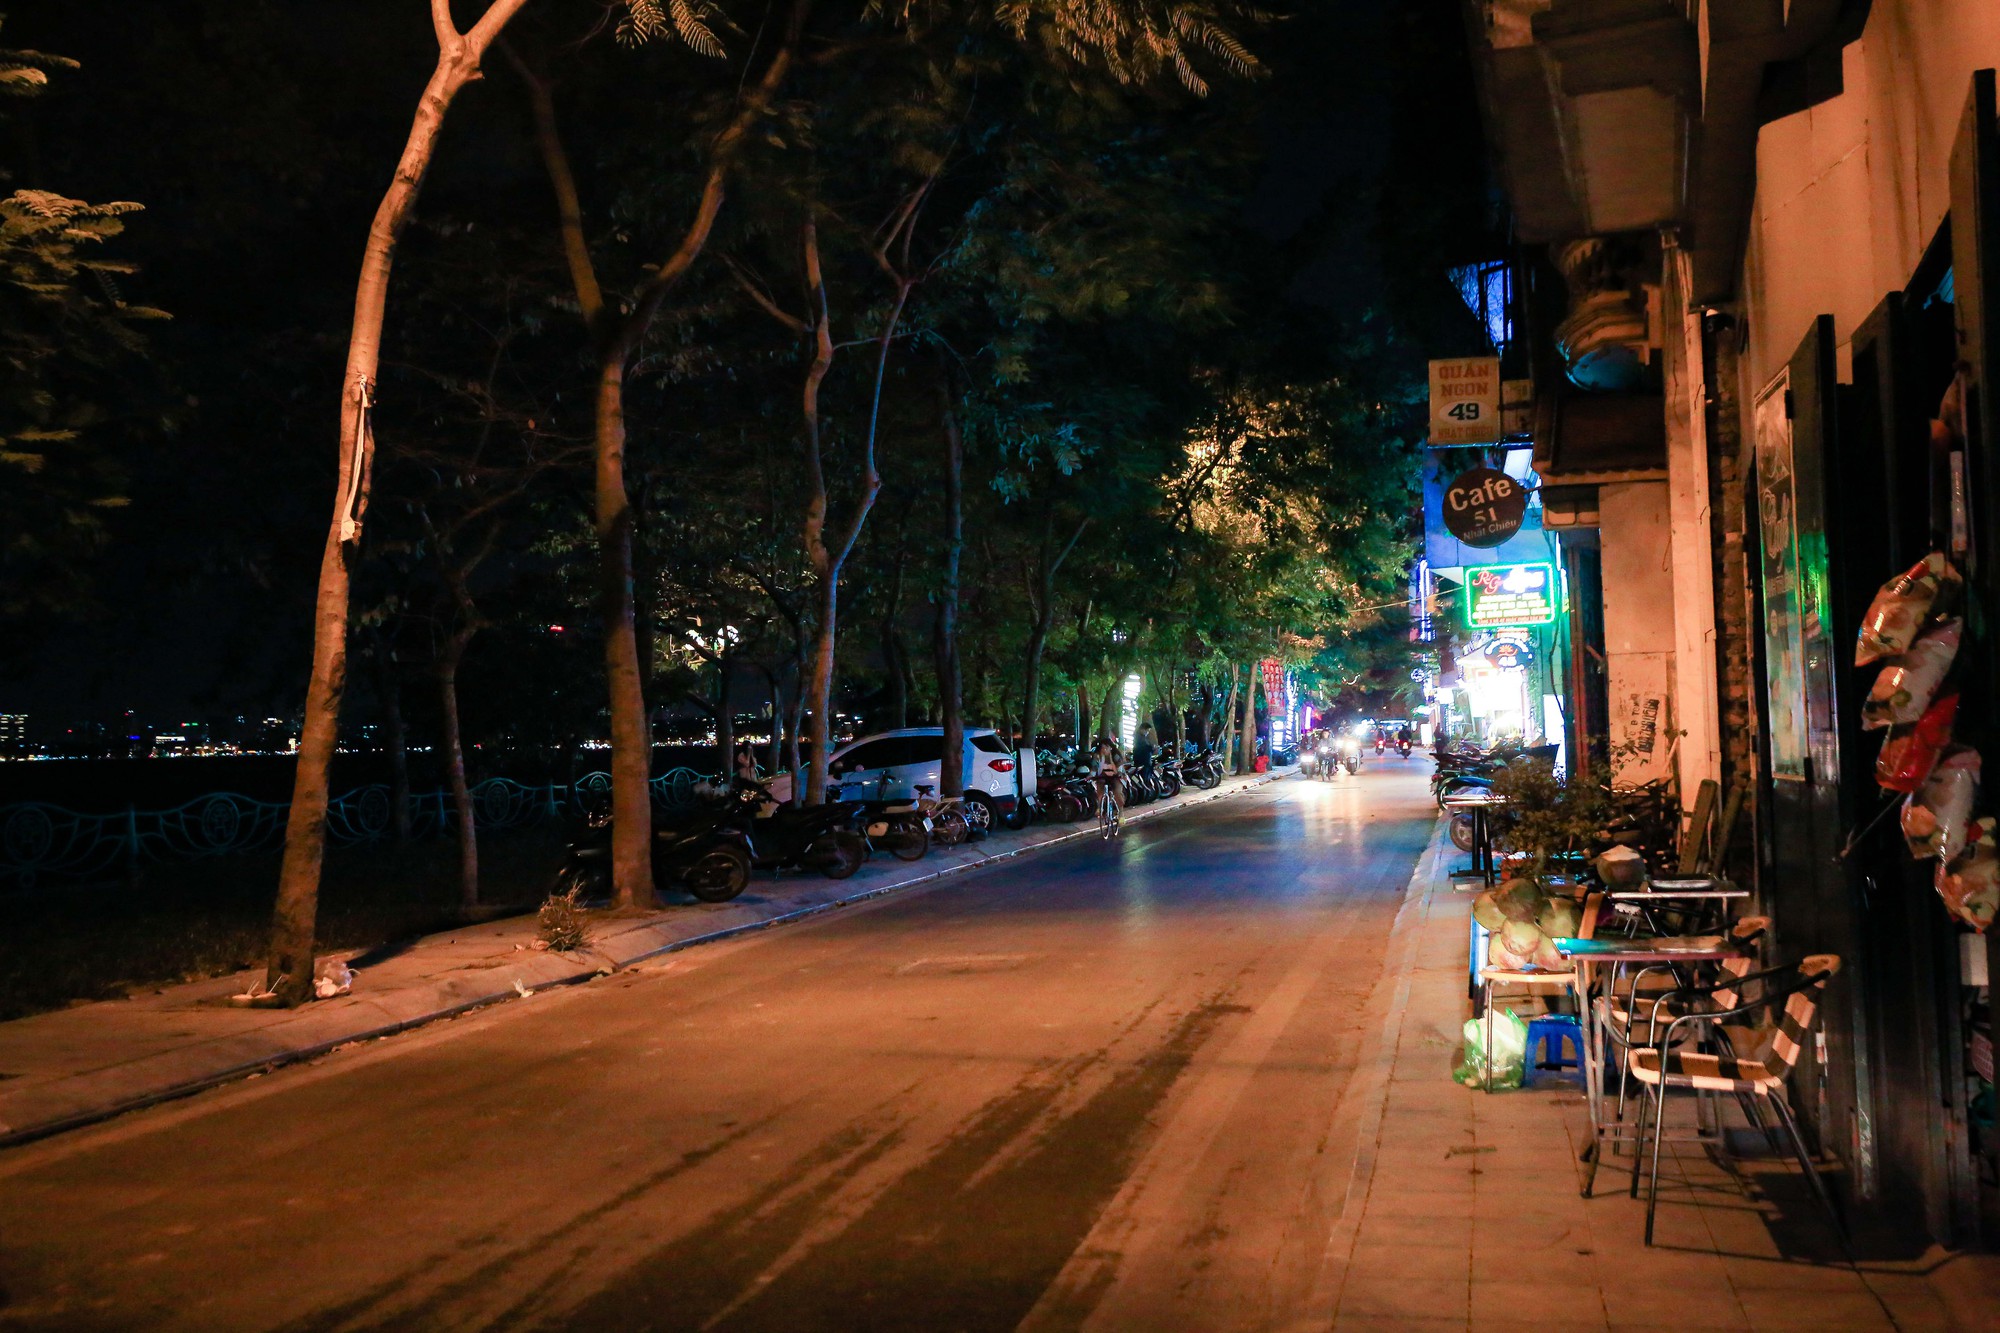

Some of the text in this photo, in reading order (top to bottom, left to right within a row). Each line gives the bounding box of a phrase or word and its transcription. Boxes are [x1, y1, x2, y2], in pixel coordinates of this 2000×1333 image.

[1441, 382, 1489, 397] NGON
[1448, 403, 1479, 420] 49
[1449, 478, 1512, 511] Cafe
[1474, 507, 1497, 526] 51
